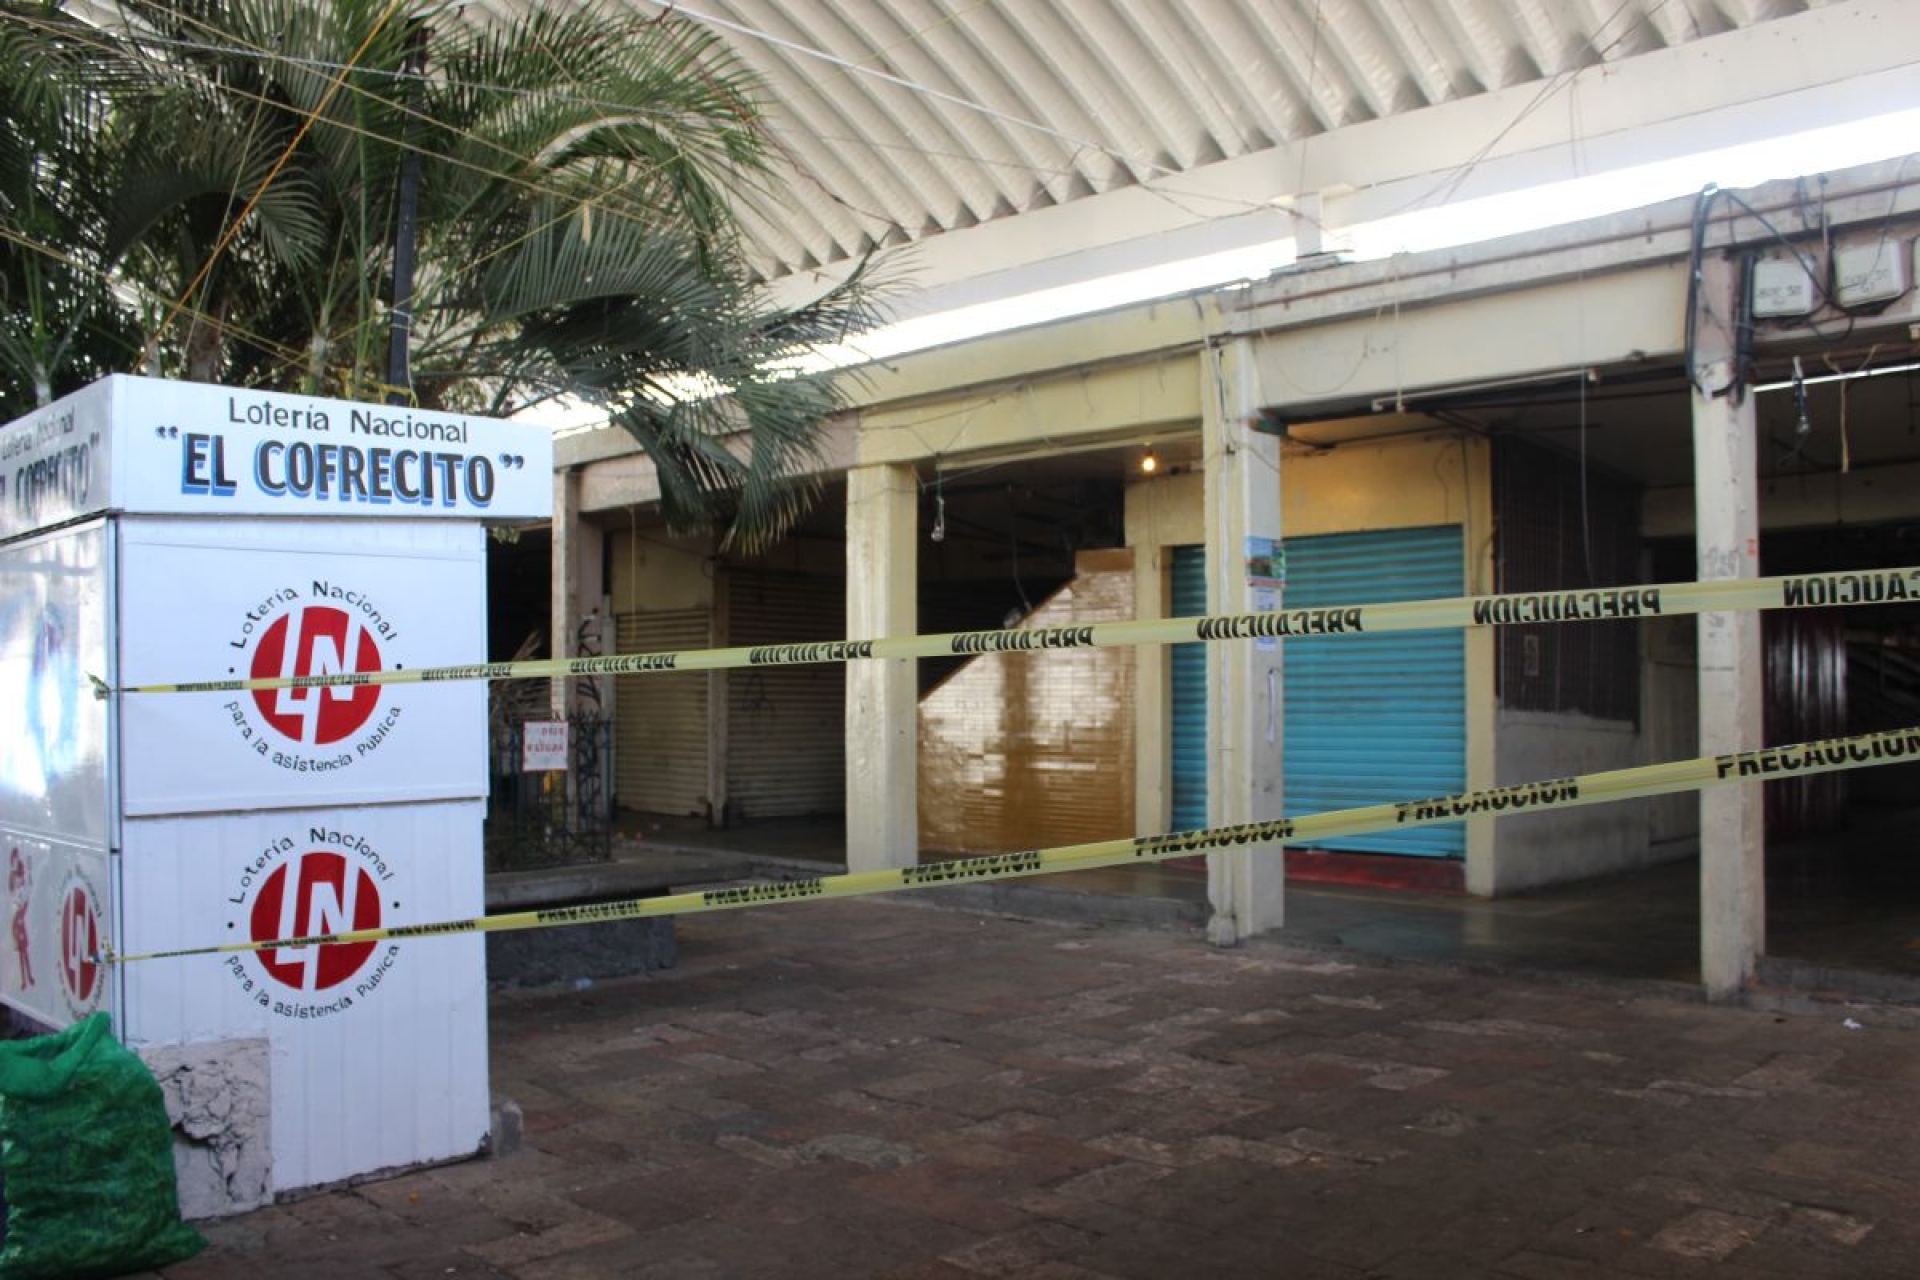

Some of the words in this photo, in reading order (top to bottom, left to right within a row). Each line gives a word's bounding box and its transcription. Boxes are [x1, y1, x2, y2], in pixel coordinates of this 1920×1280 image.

[351, 409, 468, 443] Nacional
[312, 580, 397, 641] Nacional
[223, 701, 253, 739] para
[252, 737, 270, 756] la
[272, 751, 353, 772] asistencia
[309, 827, 396, 881] Nacional
[223, 955, 254, 992] para
[254, 988, 270, 1006] la
[273, 996, 353, 1019] asistencia
